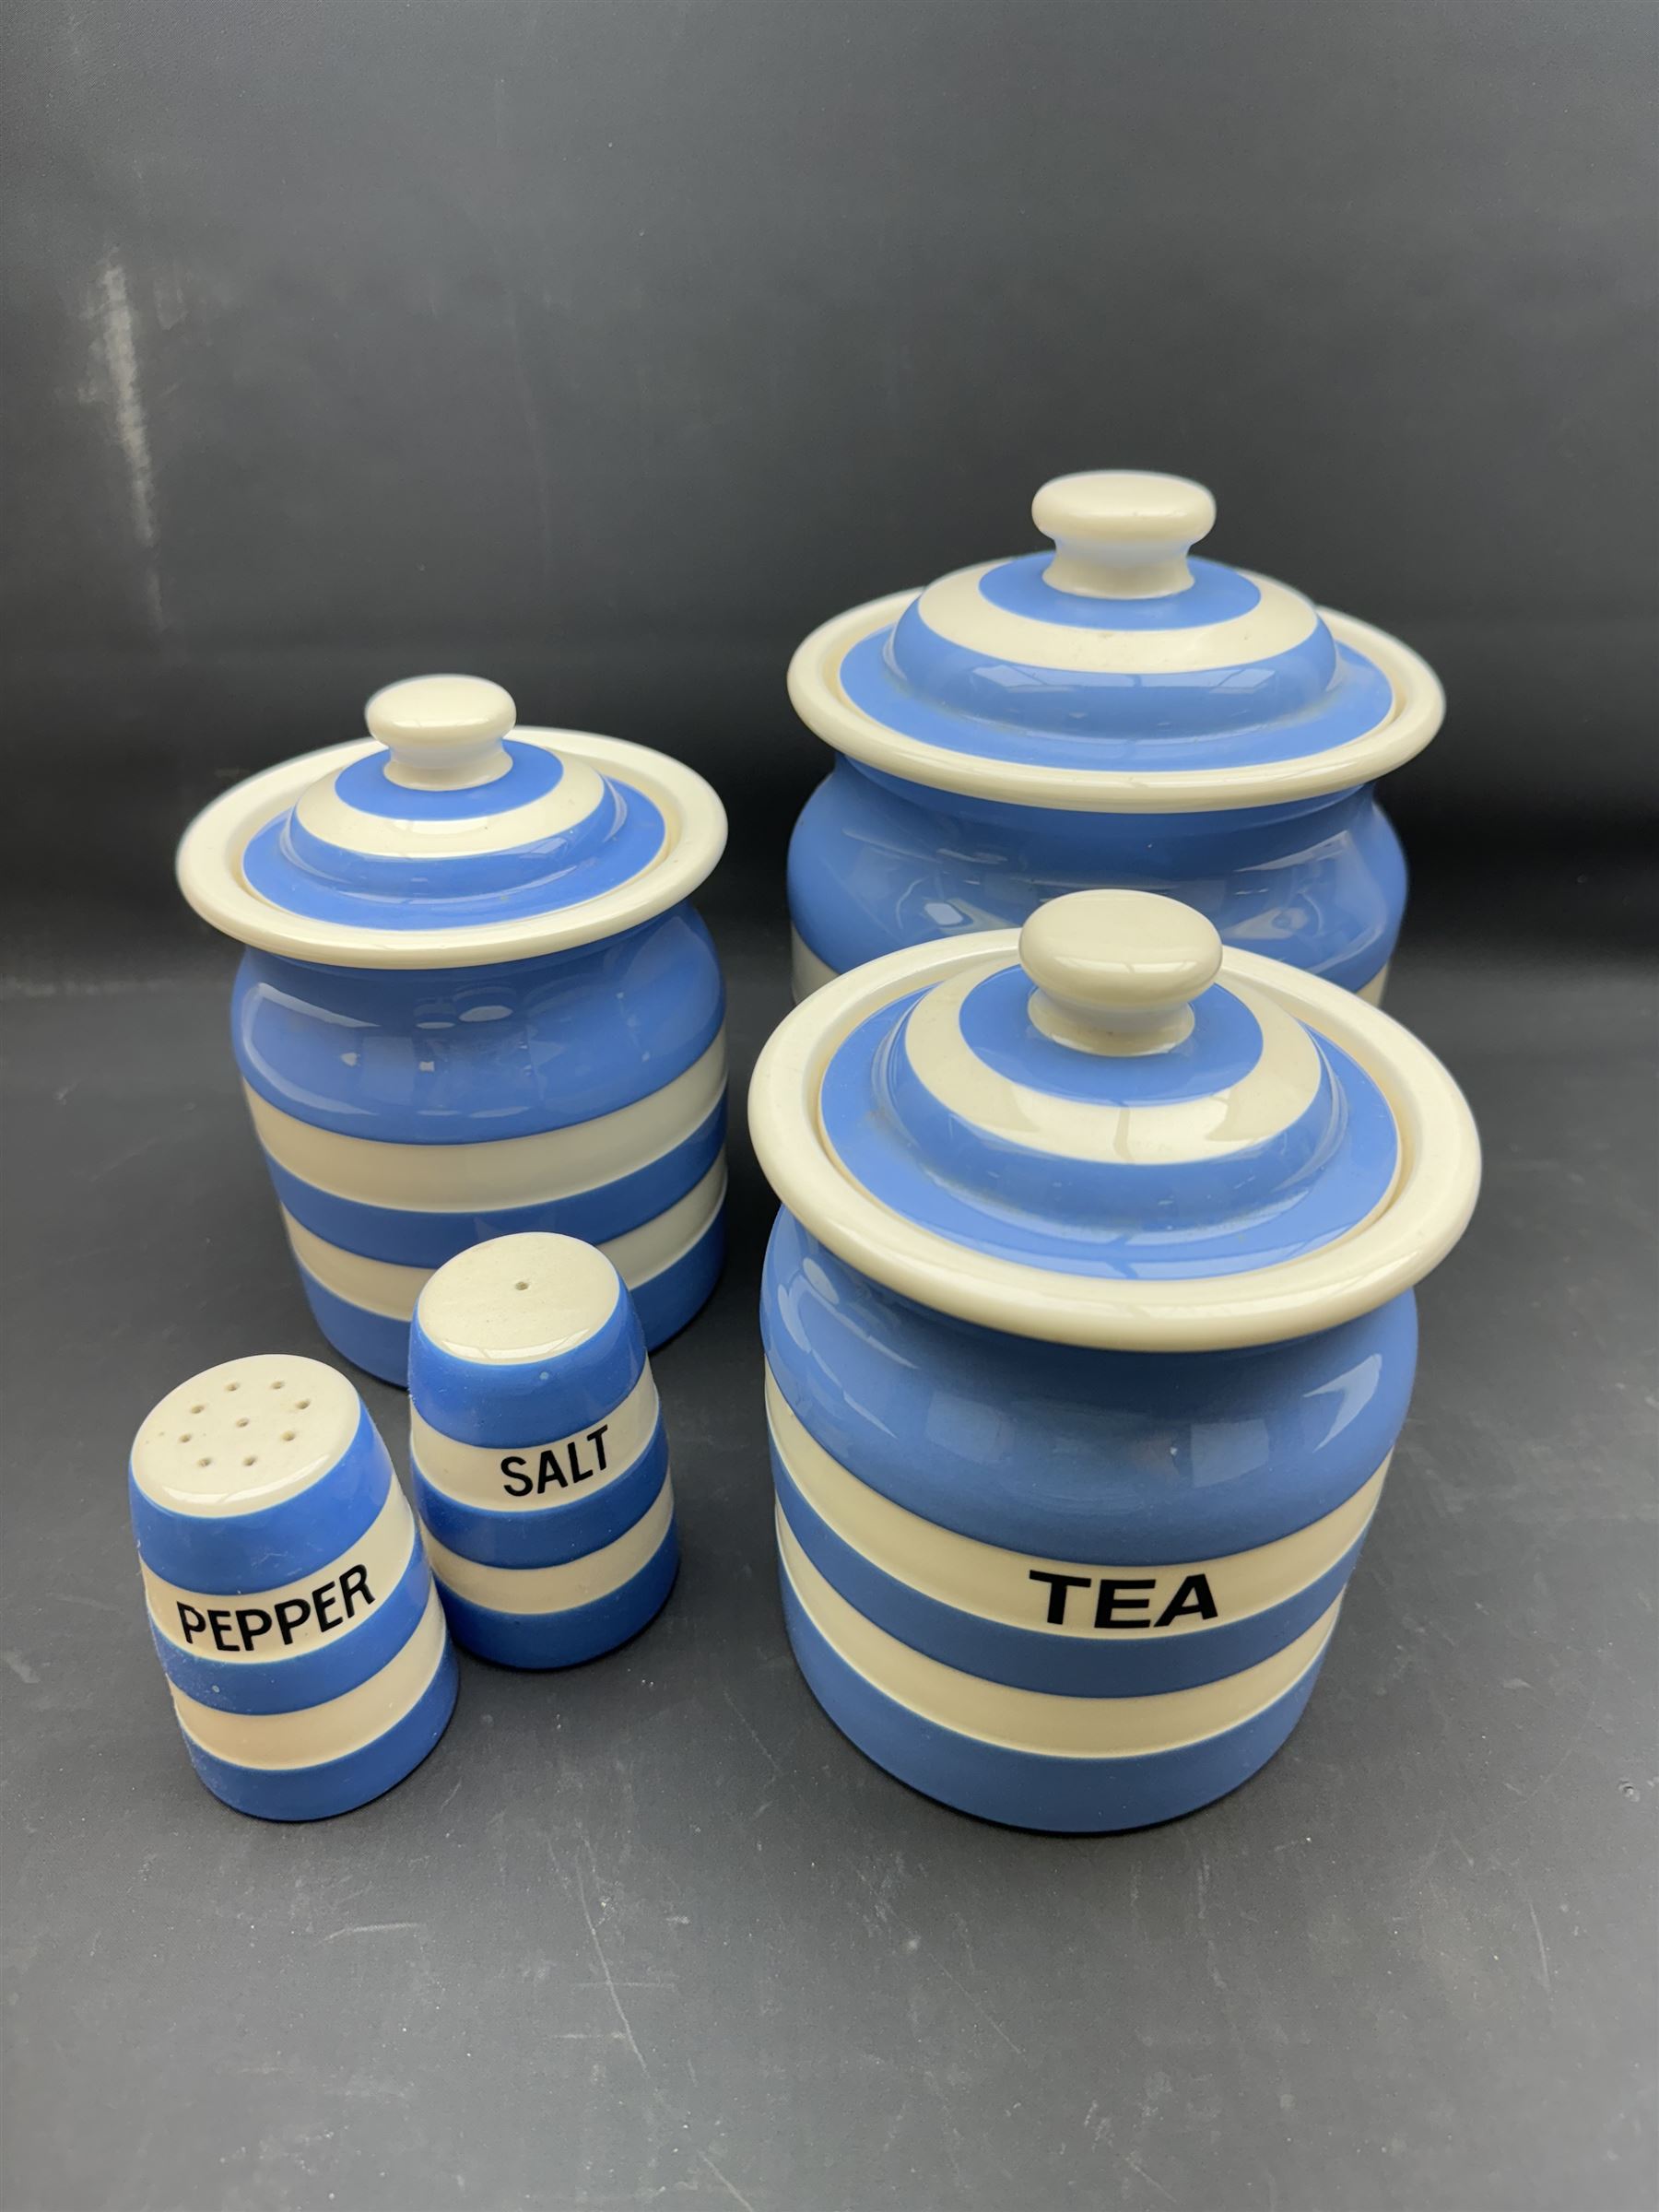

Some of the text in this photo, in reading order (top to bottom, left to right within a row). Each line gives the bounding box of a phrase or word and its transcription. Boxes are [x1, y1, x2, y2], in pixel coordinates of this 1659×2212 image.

[501, 1425, 610, 1497] SALT
[176, 1564, 375, 1652] PEPPER
[1029, 1570, 1218, 1630] TEA
